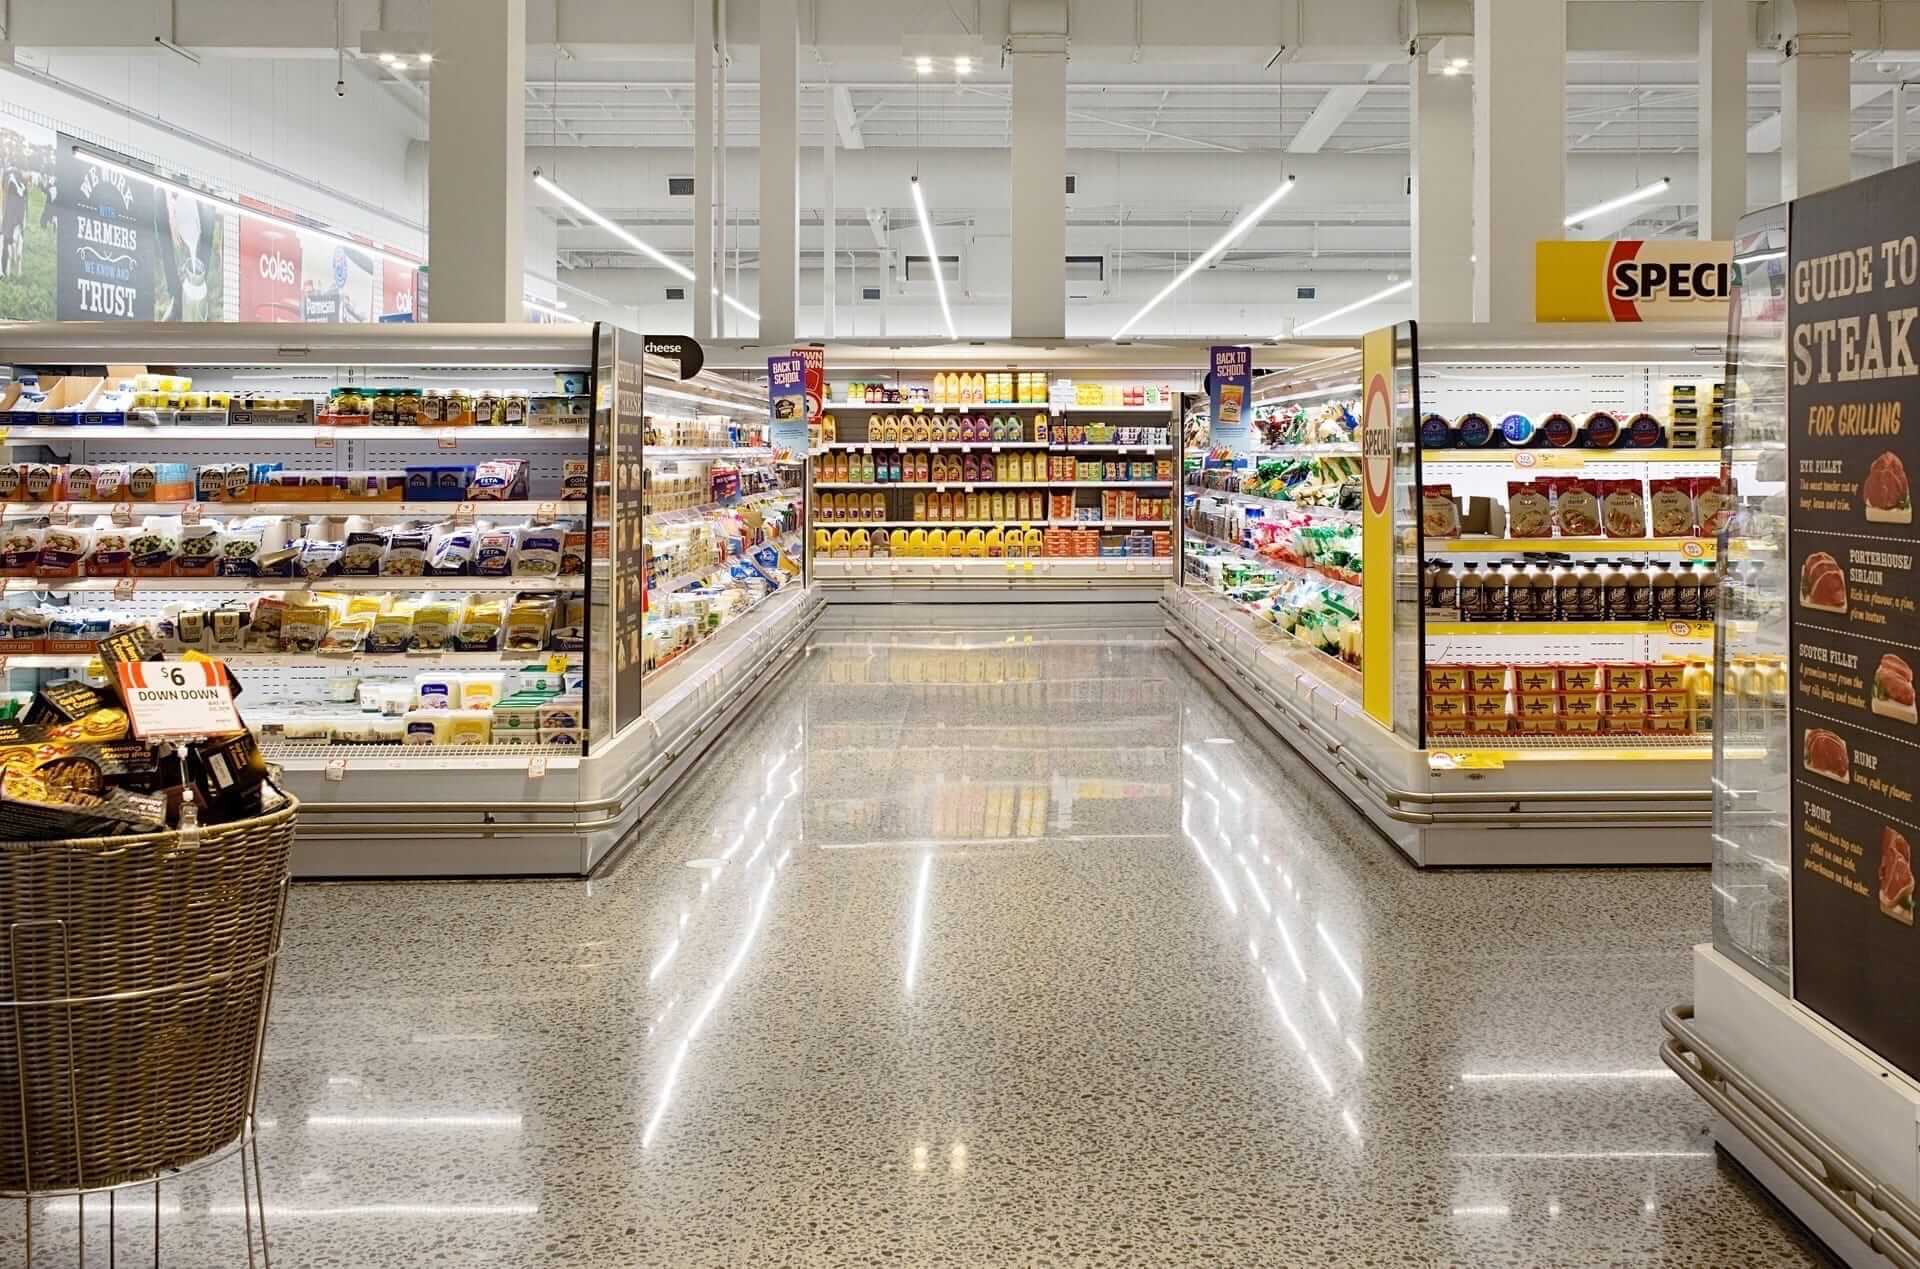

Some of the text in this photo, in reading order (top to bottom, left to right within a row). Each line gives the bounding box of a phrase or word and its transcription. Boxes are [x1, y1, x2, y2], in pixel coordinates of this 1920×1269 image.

[80, 167, 98, 199] WE
[77, 215, 136, 250] FARMERS
[259, 250, 295, 285] coles
[1795, 235, 1917, 304] GUIDE TO
[1615, 262, 1731, 298] SPECI
[78, 278, 136, 317] TRUST
[644, 343, 682, 353] cheese
[1216, 351, 1246, 364] BACK TO
[1793, 307, 1919, 386] STEAK
[773, 360, 801, 374] BACK TO
[774, 371, 801, 385] SCHOOL
[1217, 363, 1246, 377] SCHOOL
[1808, 401, 1901, 436] FOR GRILLING
[1365, 429, 1391, 456] SPECIAL
[1816, 460, 1843, 474] FILLET
[70, 481, 89, 489] FETTA
[1849, 549, 1913, 571] PORTERHOUSE/
[1849, 567, 1884, 586] SIRLOIN
[1799, 643, 1858, 670] SCOTCH FILLET
[138, 689, 219, 702] DOWN DOWN
[1854, 750, 1878, 770] RUMP
[1804, 800, 1832, 825] T-BONE
